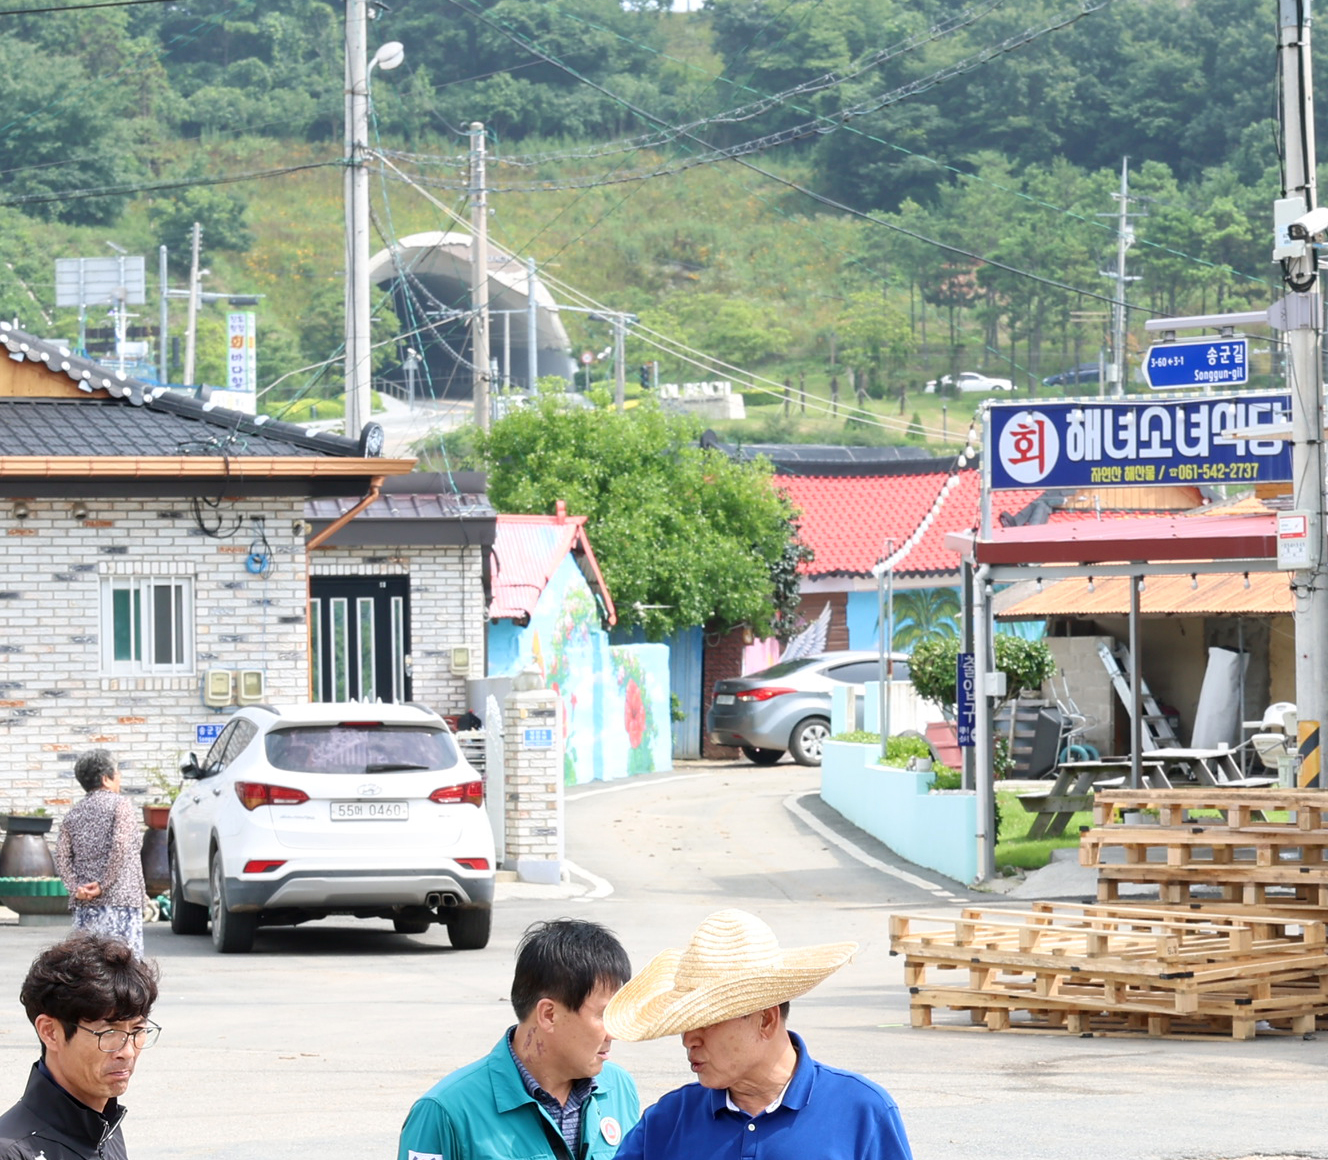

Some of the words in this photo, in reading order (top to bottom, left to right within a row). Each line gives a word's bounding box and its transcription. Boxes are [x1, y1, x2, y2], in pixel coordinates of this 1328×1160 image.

[1206, 344, 1244, 366] 송군길
[1194, 367, 1243, 382] Songgun-gil
[1065, 402, 1284, 462] 해녀소녀식당
[1007, 419, 1045, 475] 회
[1090, 467, 1121, 483] 자연산
[1124, 465, 1156, 482] 해산물
[1177, 462, 1259, 480] 061-542-2737
[369, 804, 401, 816] 0460
